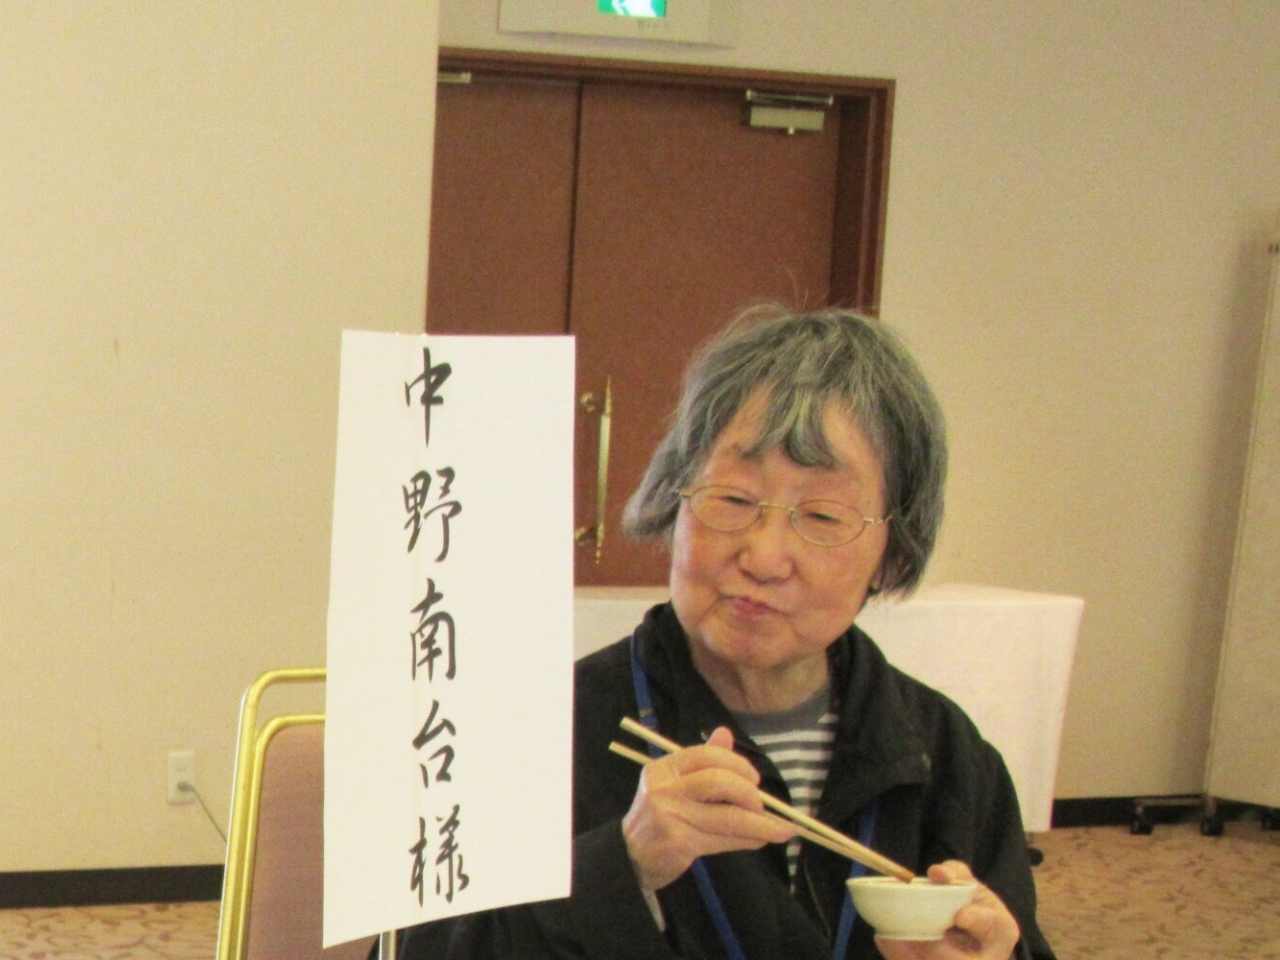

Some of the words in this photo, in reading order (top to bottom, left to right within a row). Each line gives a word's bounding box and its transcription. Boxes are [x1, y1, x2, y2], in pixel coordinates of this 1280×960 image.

[402, 346, 470, 905] 中野南台様
